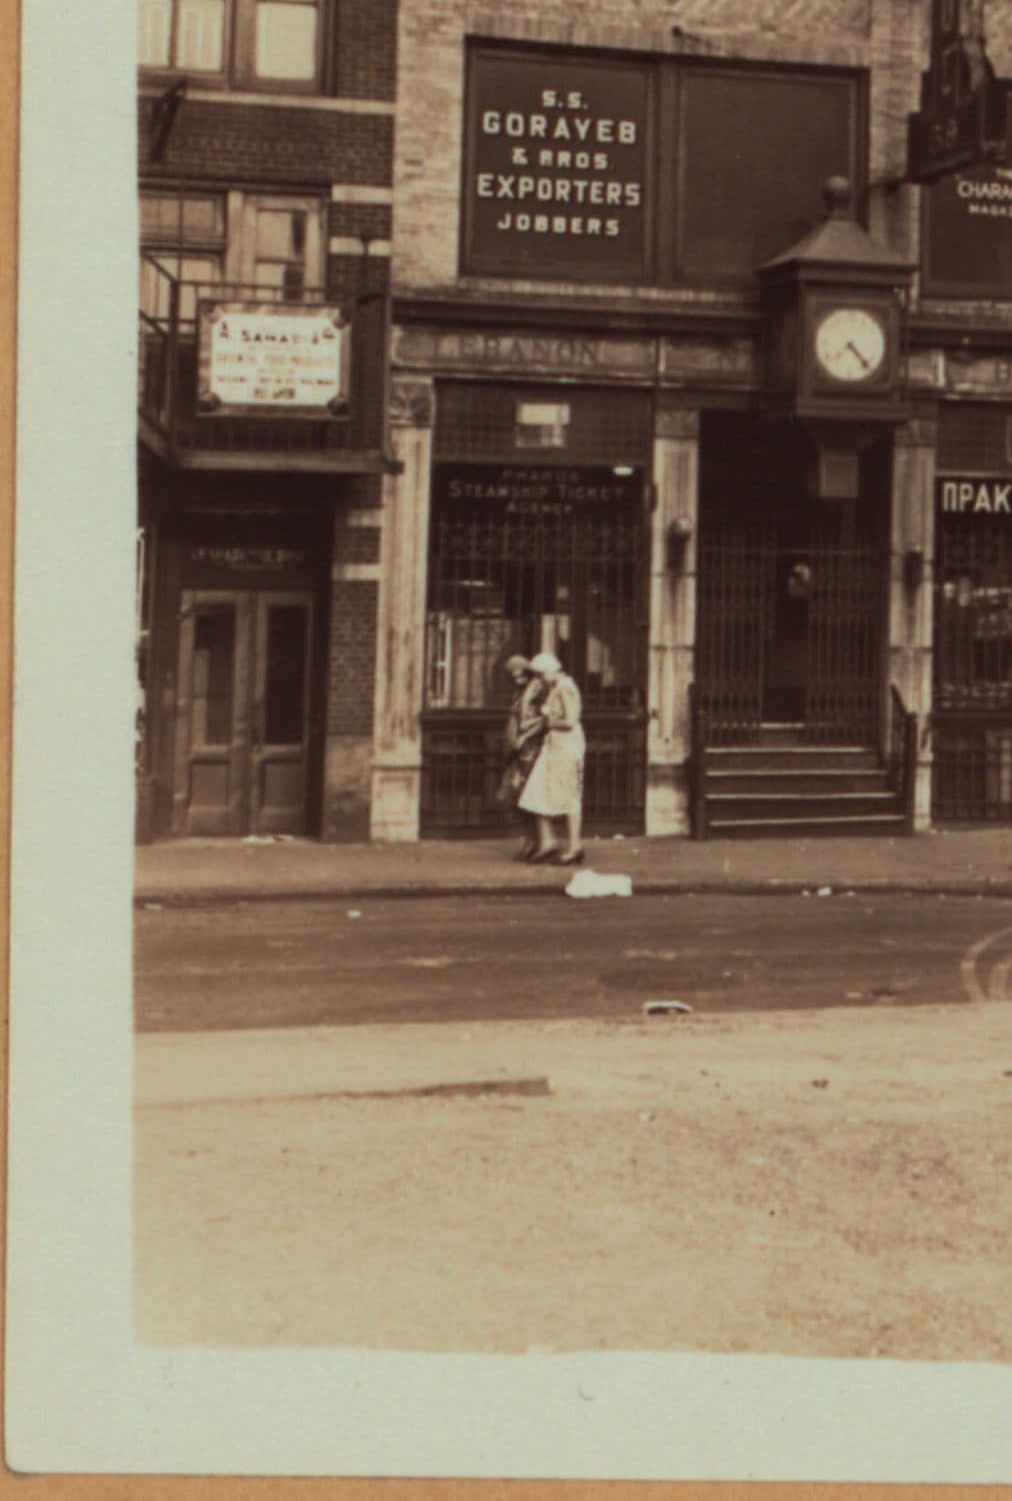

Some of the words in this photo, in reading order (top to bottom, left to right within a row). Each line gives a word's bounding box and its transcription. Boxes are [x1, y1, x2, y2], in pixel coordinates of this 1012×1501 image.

[542, 89, 588, 109] S.S.
[482, 110, 637, 145] GORAYEB
[511, 148, 528, 166] &
[477, 173, 641, 206] EXPORTERS
[498, 212, 620, 236] JOBBERS
[448, 479, 549, 499] STEAMSHIP
[558, 483, 625, 500] TICKET
